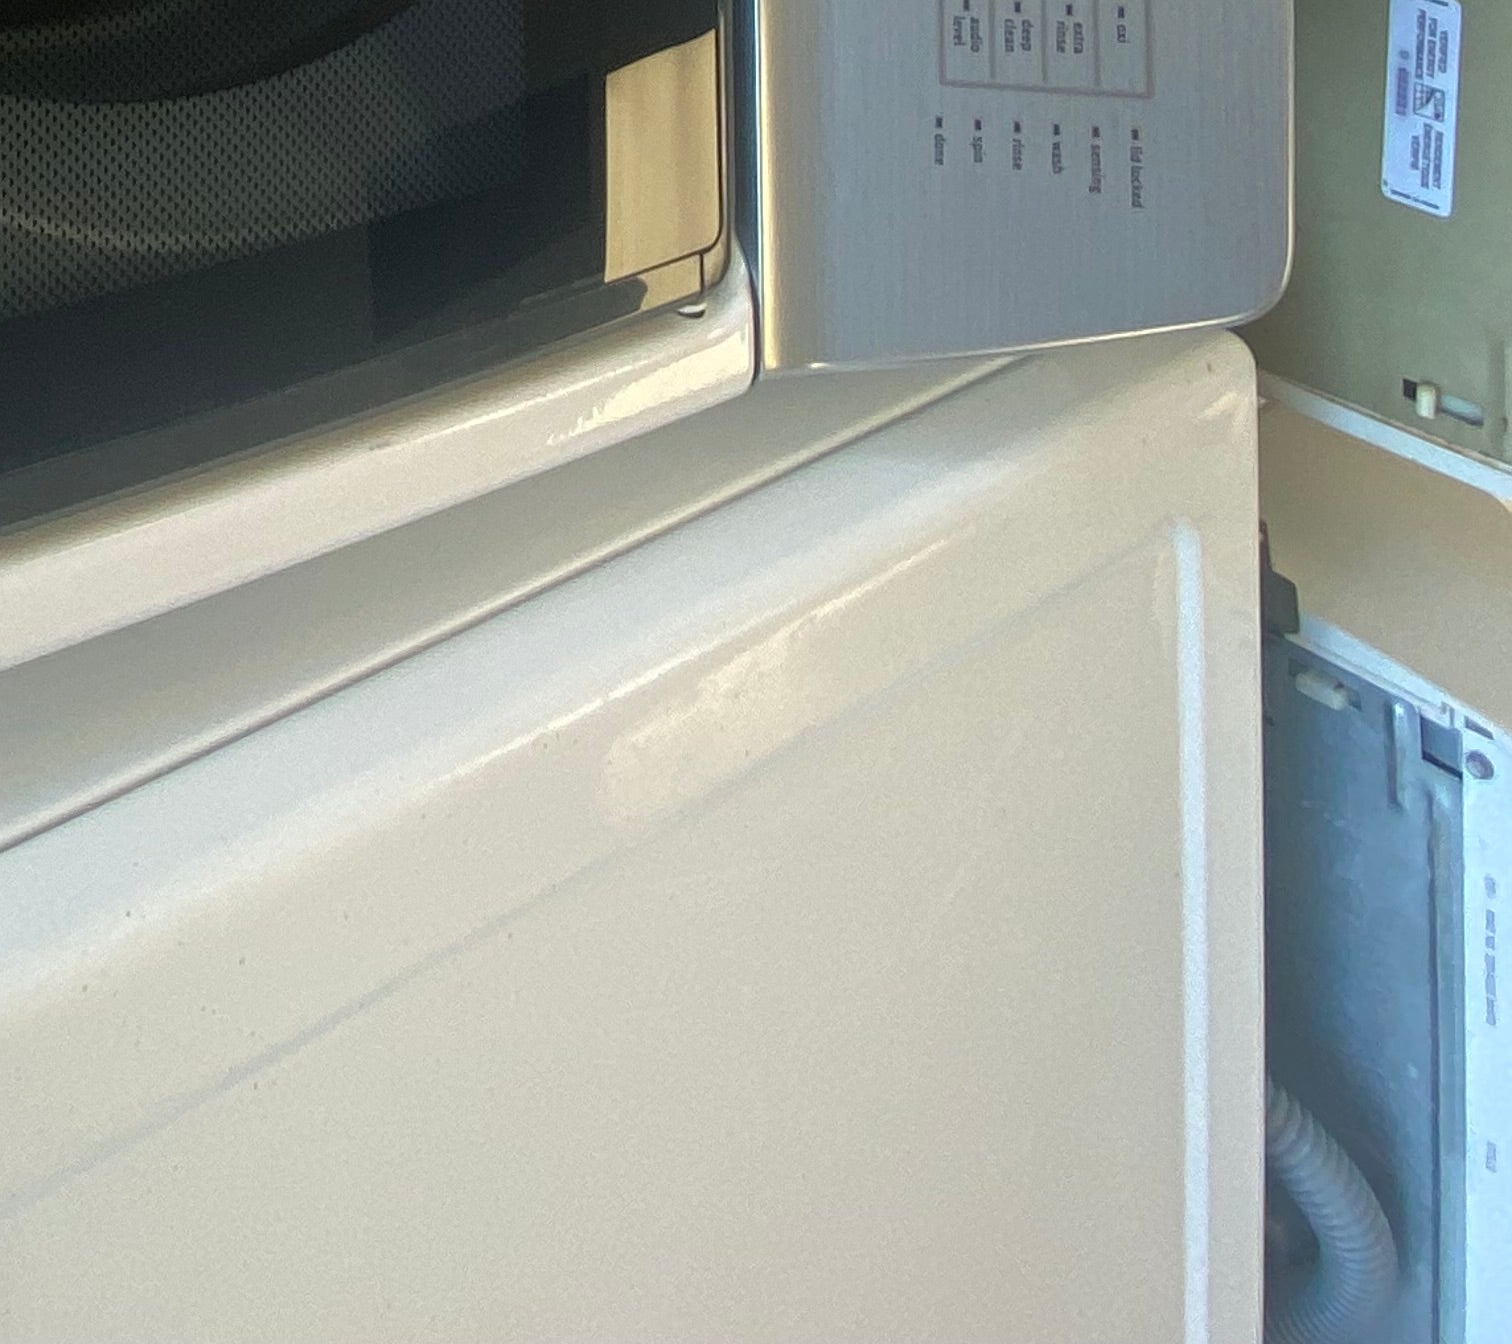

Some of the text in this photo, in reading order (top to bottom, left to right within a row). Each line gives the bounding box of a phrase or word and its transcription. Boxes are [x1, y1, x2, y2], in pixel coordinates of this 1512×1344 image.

[953, 15, 966, 47] level
[970, 16, 983, 53] audio
[1004, 18, 1018, 53] clean
[1020, 18, 1035, 52] deep
[1056, 20, 1070, 53] rinse
[1073, 22, 1085, 54] extra
[934, 132, 947, 166] done
[970, 135, 985, 163] spin
[1088, 143, 1105, 195] sensing
[1131, 165, 1145, 209] locked
